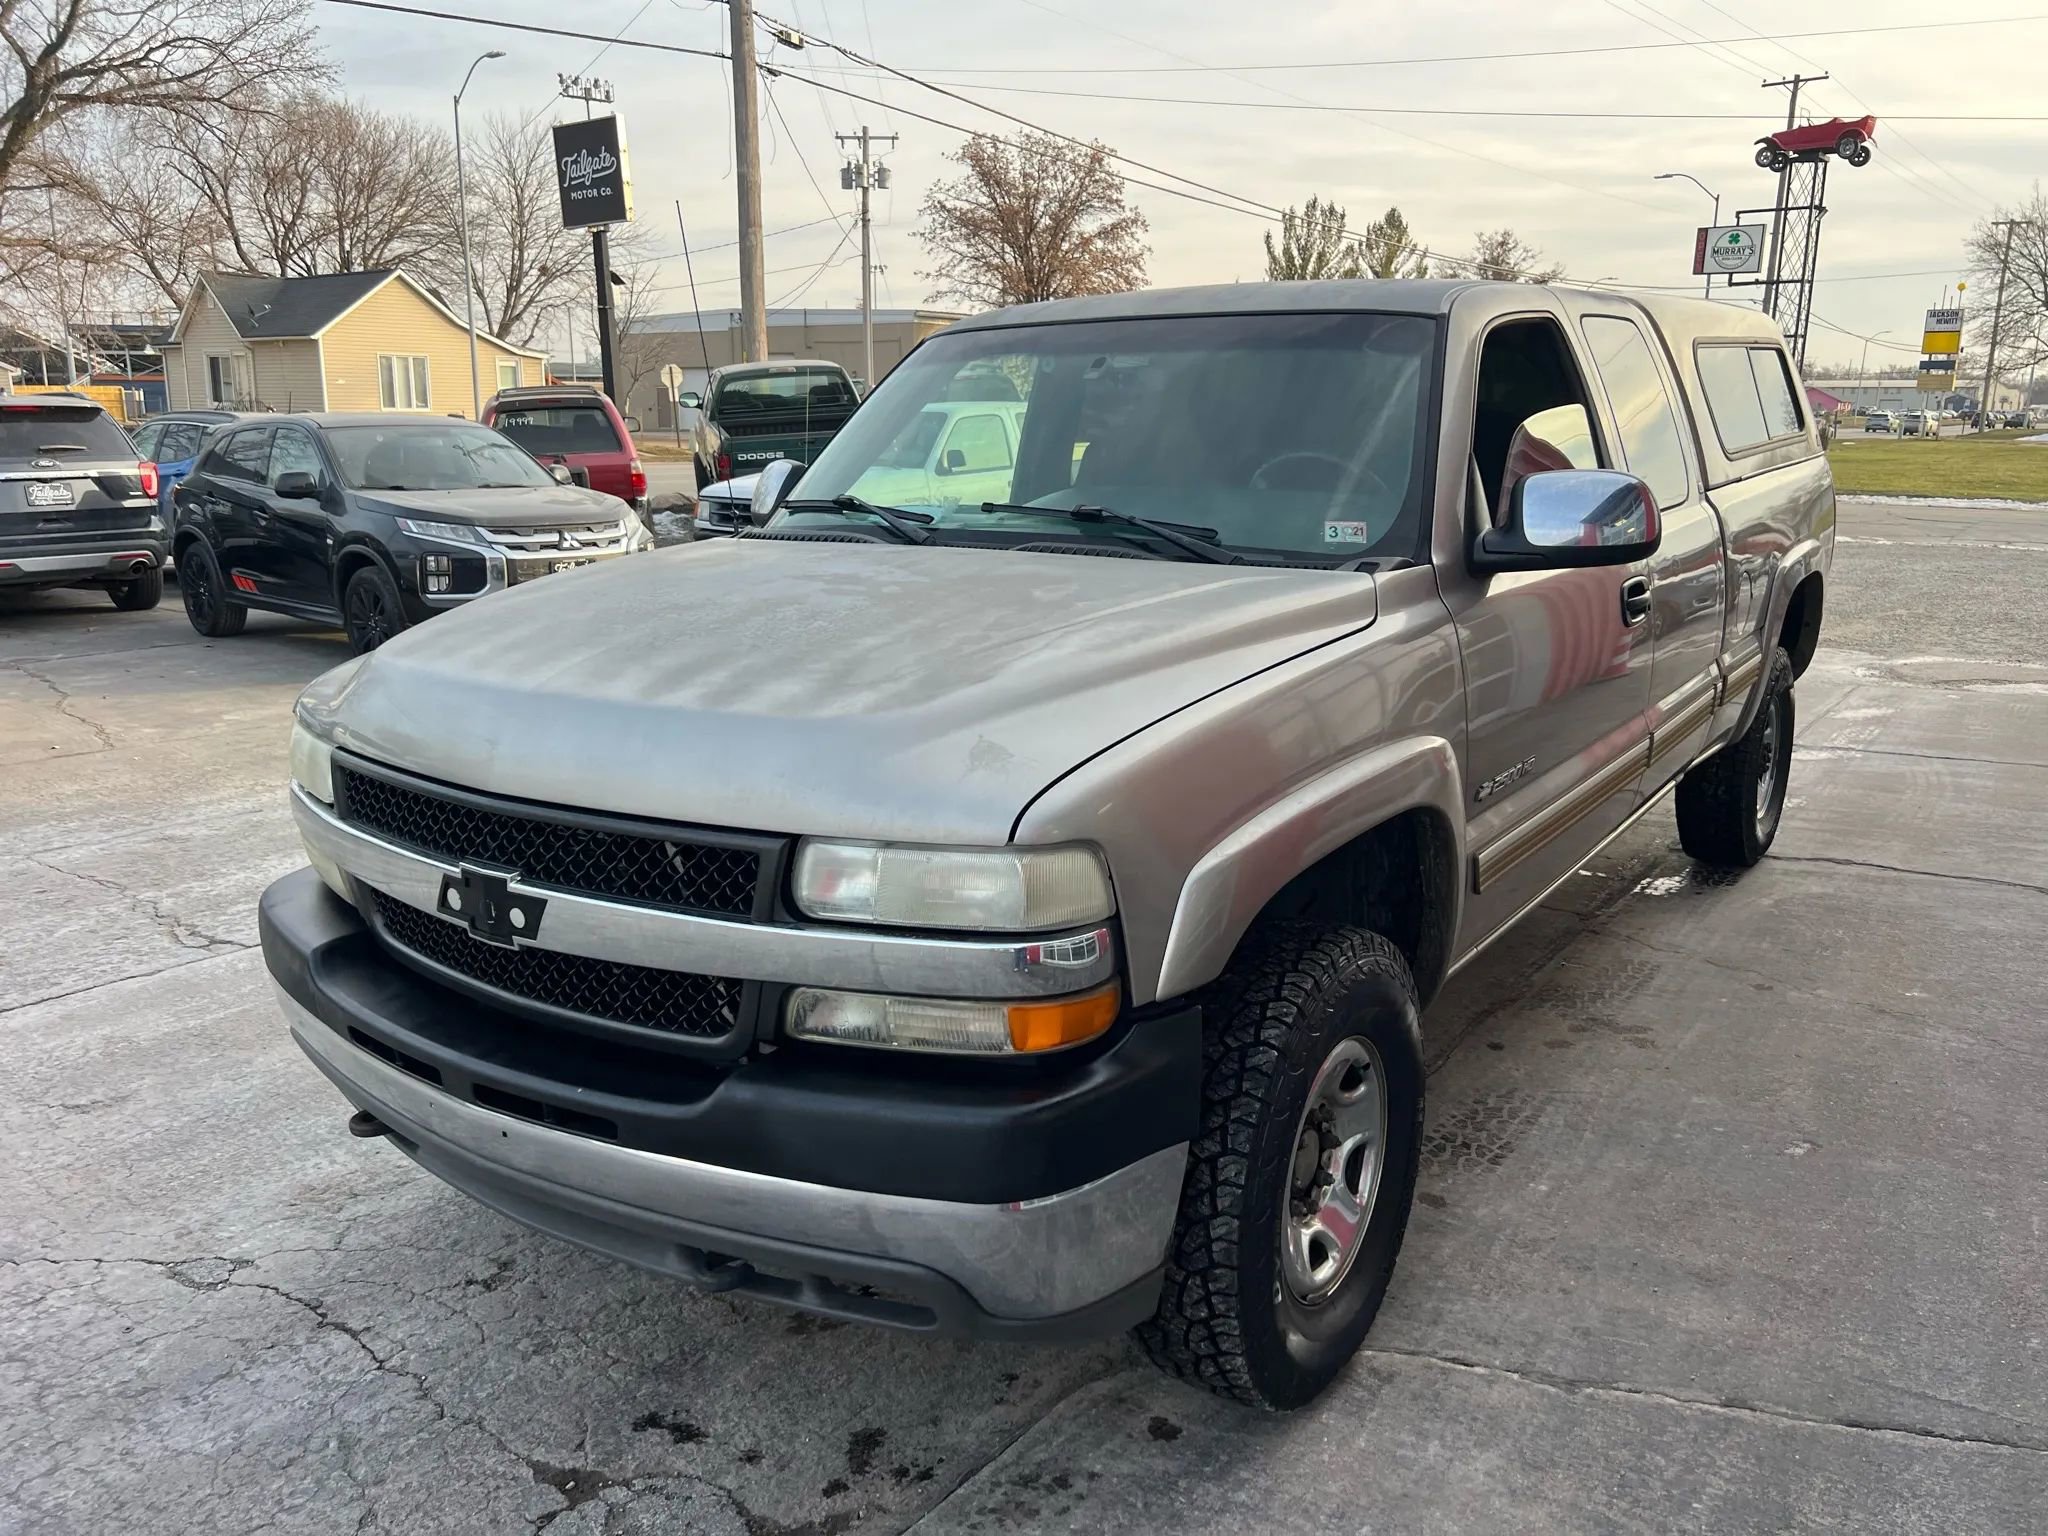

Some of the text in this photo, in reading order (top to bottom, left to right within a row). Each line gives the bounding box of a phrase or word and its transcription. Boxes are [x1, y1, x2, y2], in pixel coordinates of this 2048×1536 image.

[562, 146, 617, 187] Tailgate
[571, 188, 598, 200] MOTOR
[1712, 246, 1754, 256] MURRAY'S
[737, 451, 785, 461] DODGE
[1328, 525, 1364, 538] 3 21
